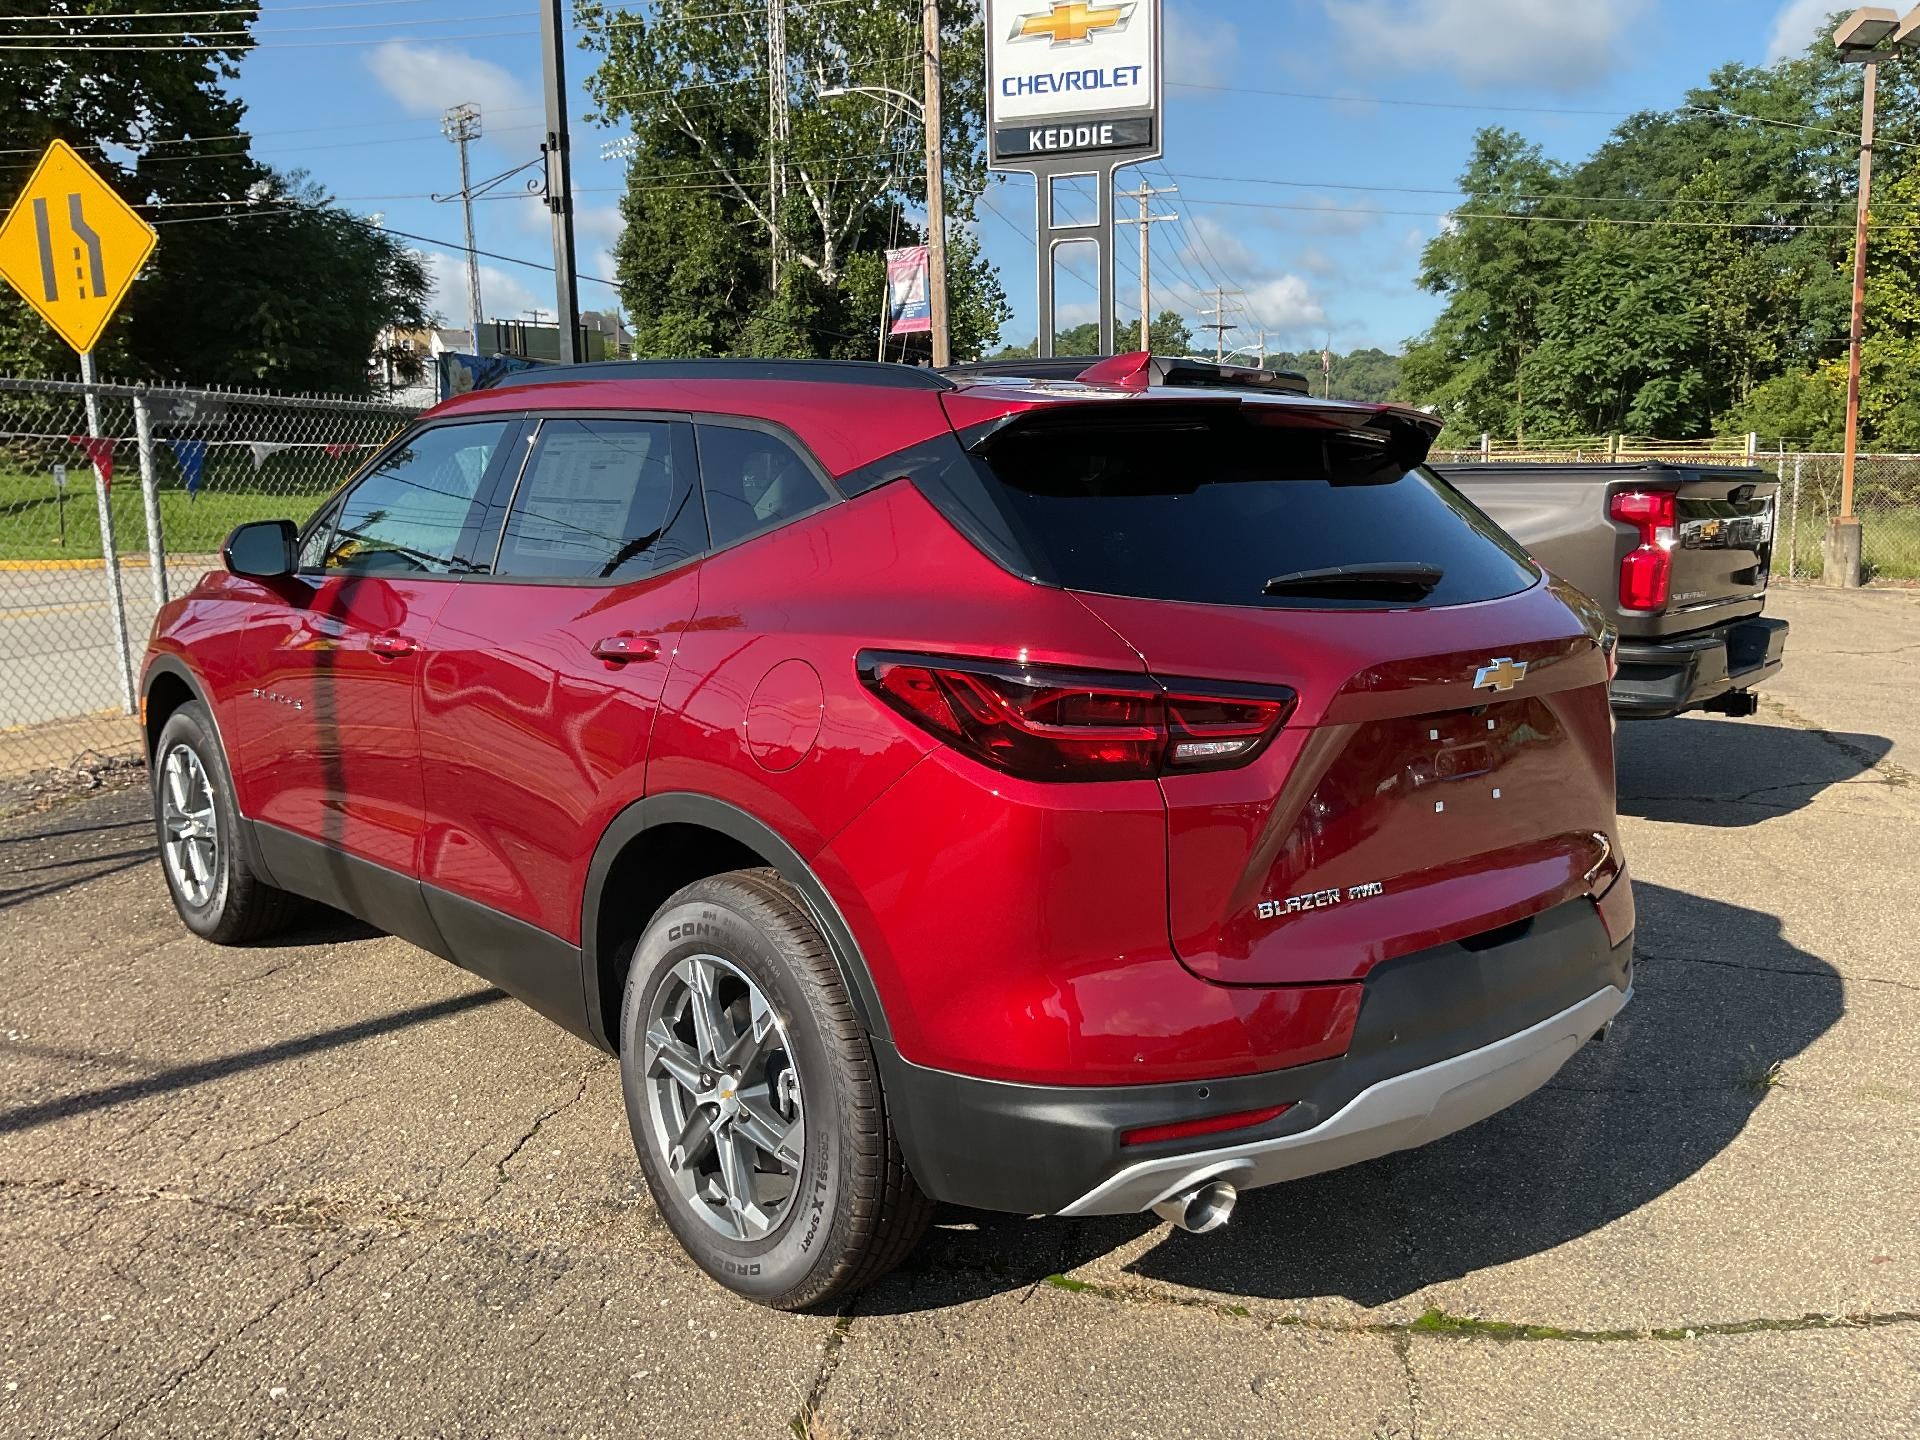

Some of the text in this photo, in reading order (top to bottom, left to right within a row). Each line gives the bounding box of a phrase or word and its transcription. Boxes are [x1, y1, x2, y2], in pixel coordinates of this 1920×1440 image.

[1002, 65, 1142, 97] CHEVROLET
[1029, 125, 1113, 150] KEDDIE
[1257, 881, 1383, 920] BLAZER AWD
[820, 1132, 829, 1181] CROSS
[801, 1213, 821, 1254] SPORT
